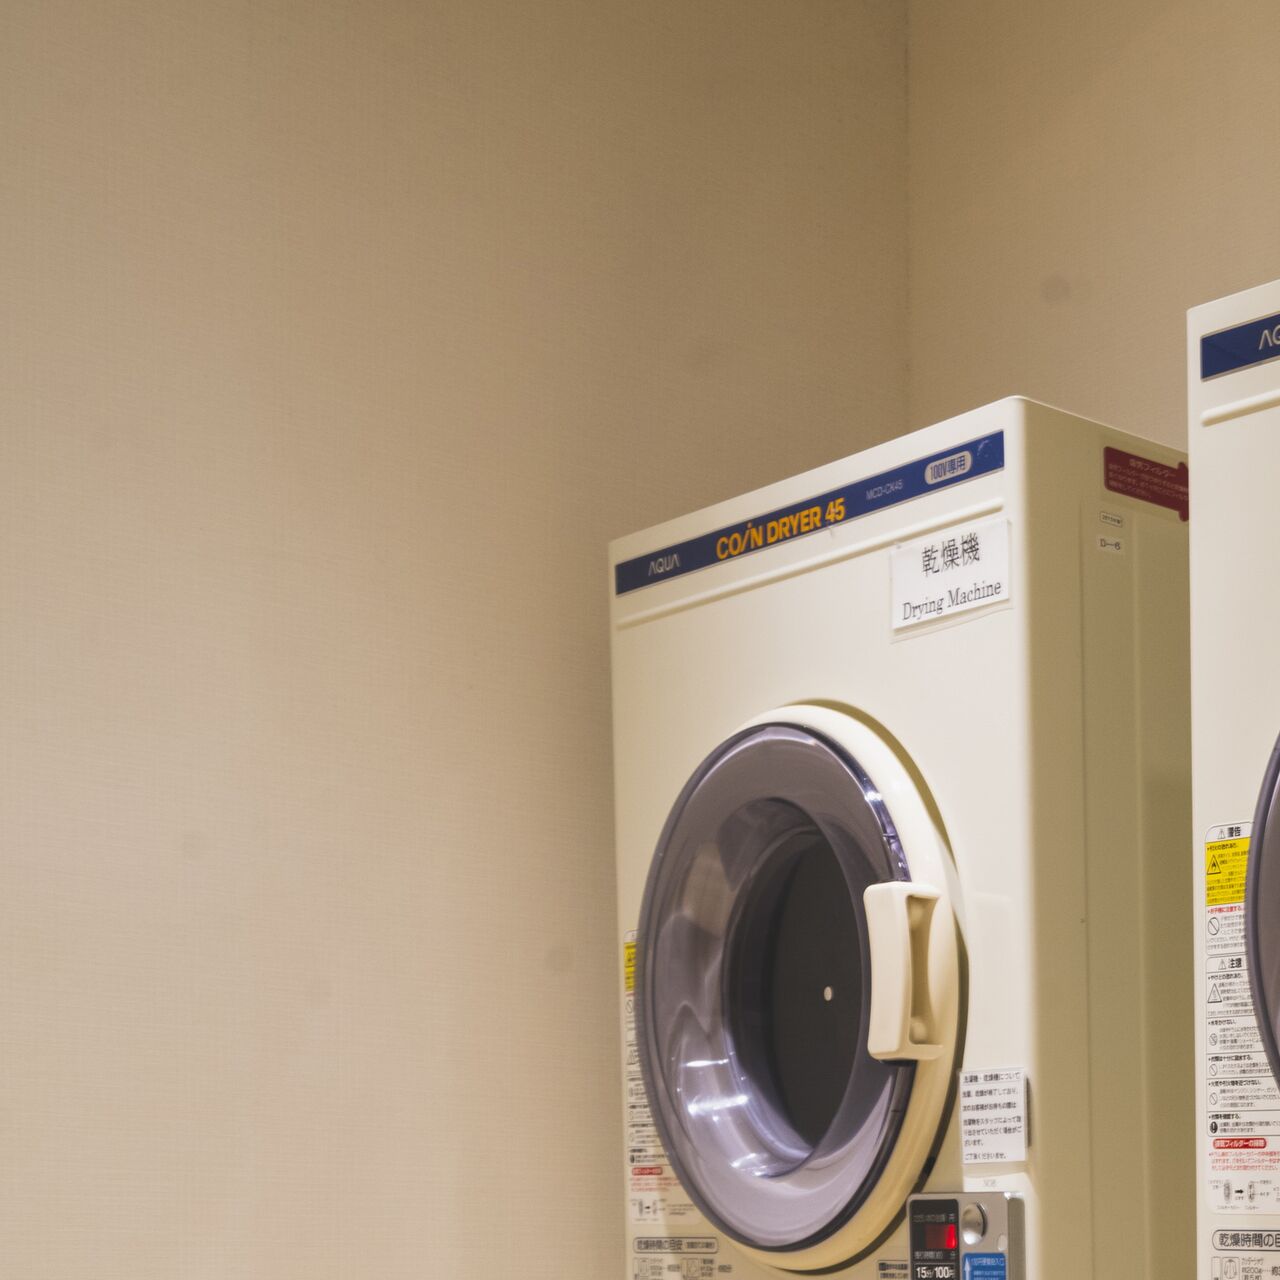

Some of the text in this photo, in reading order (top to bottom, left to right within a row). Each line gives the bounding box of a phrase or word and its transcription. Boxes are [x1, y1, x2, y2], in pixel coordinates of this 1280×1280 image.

[767, 506, 821, 541] DRYER
[825, 497, 846, 523] 45
[648, 553, 680, 577] AQUA
[921, 532, 980, 578] 乾燥機
[902, 579, 1001, 622] Drying Machine
